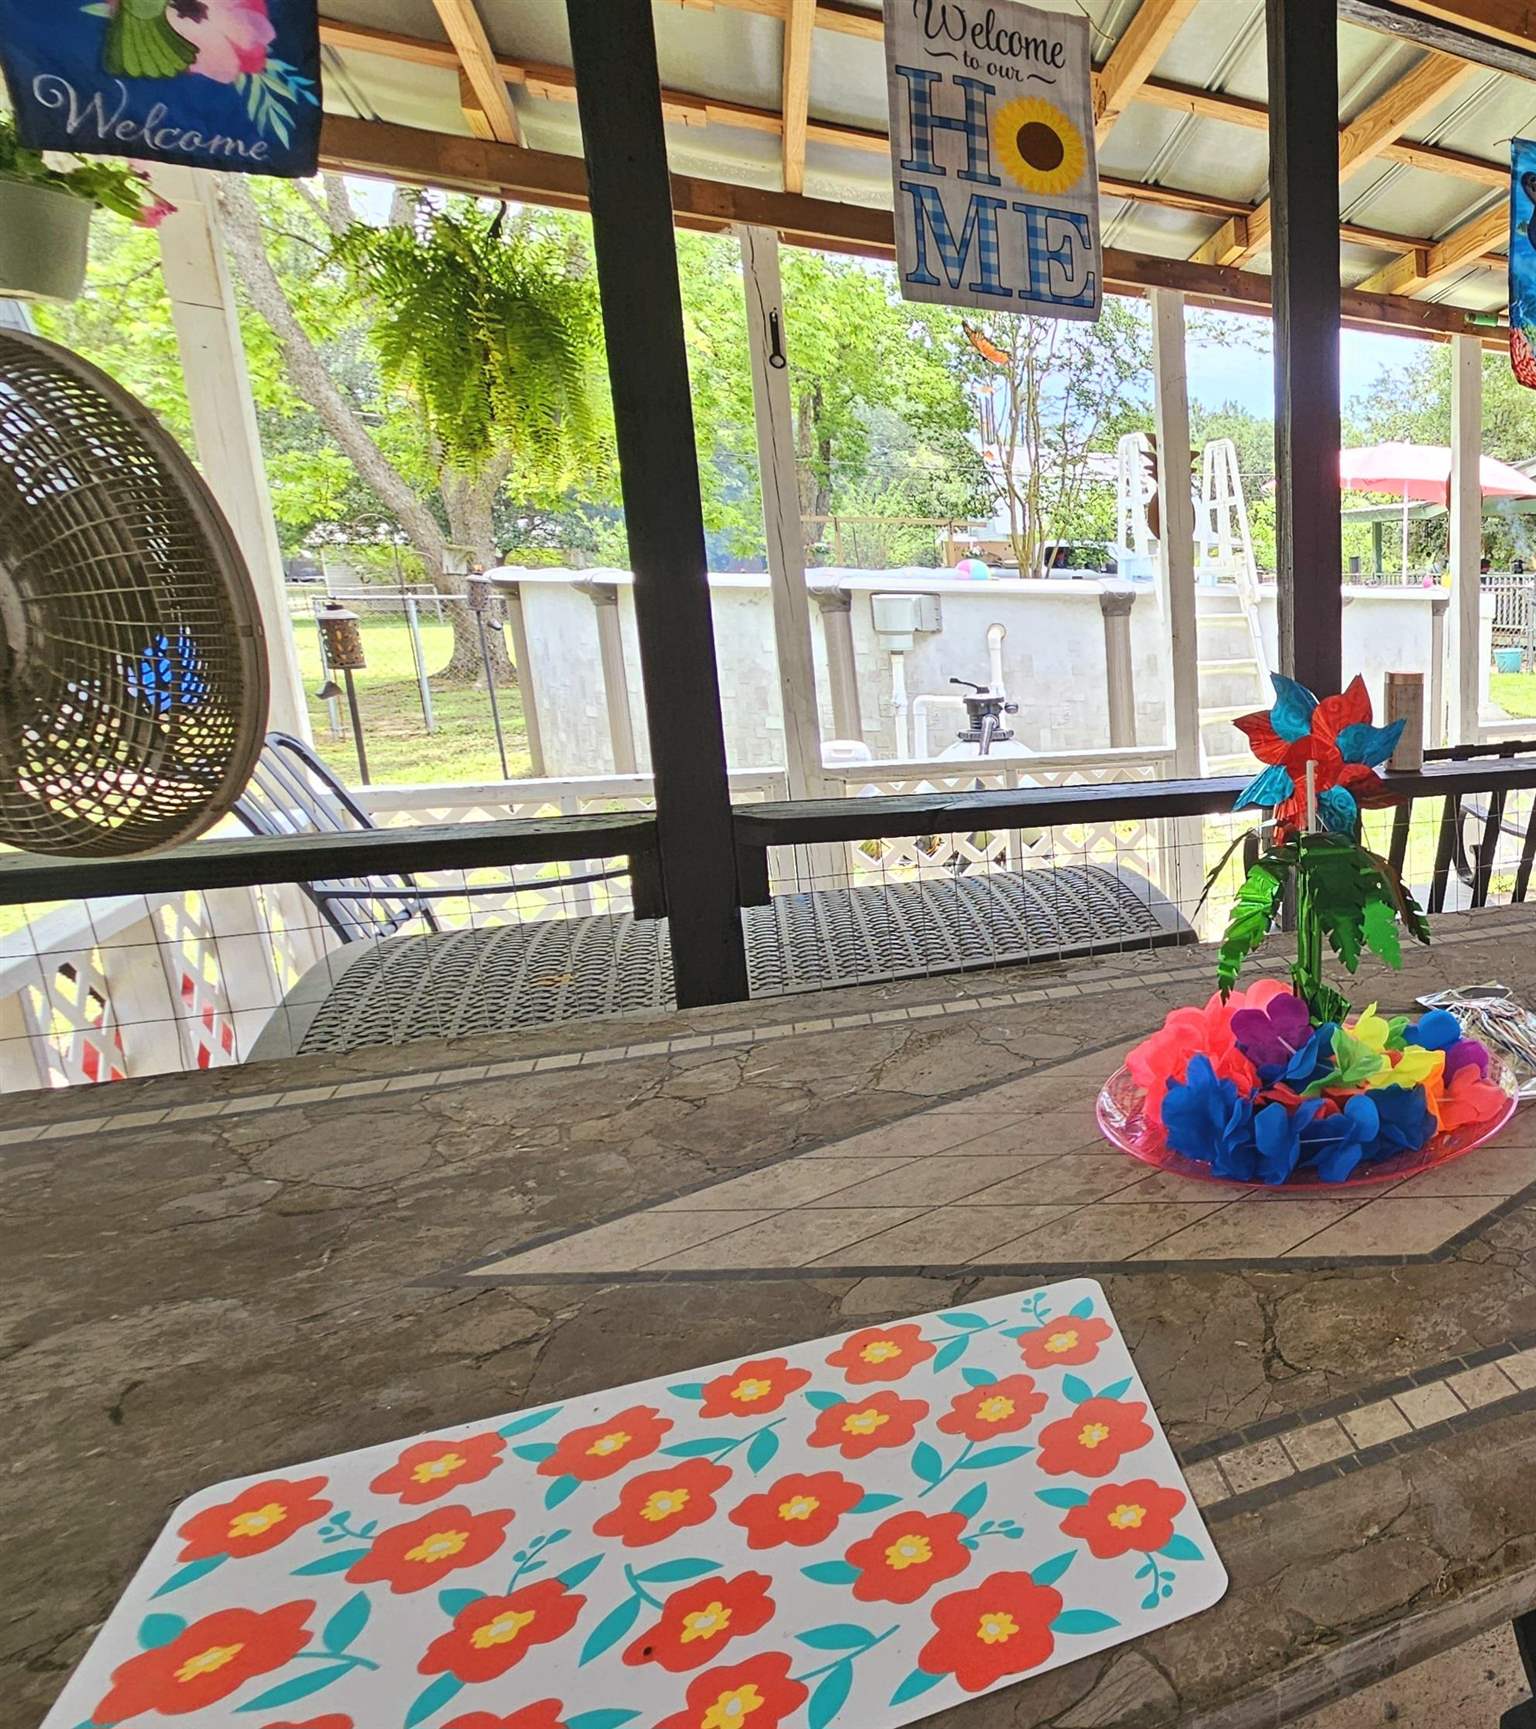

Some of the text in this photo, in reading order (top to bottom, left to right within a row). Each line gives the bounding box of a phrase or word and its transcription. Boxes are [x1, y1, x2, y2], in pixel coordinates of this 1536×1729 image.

[913, 0, 1066, 69] Welcome
[963, 49, 1025, 82] to our
[32, 73, 271, 161] Welcome
